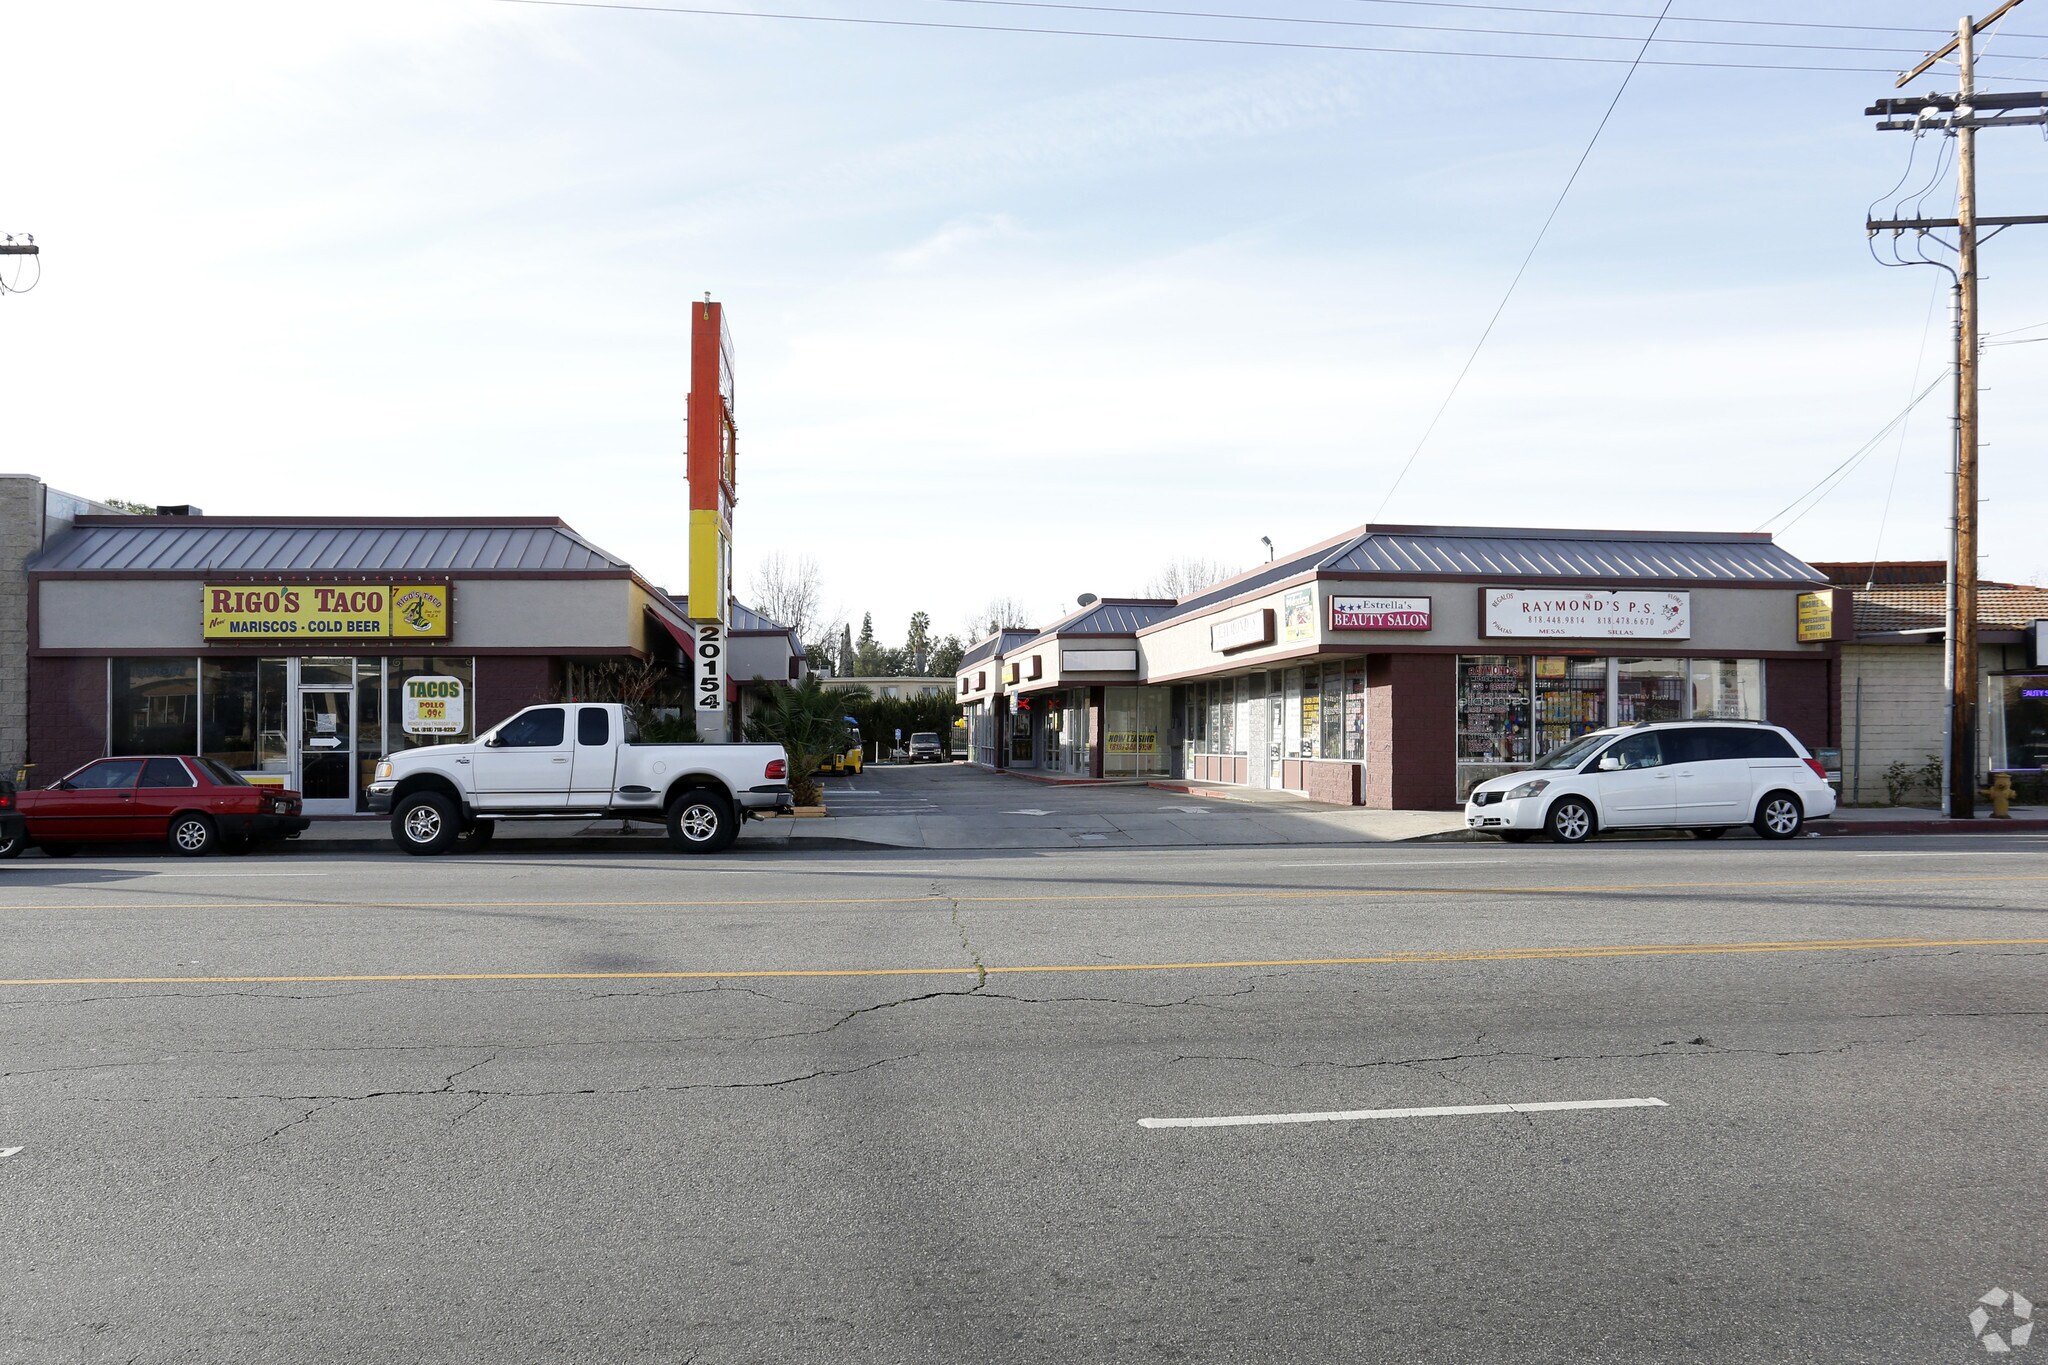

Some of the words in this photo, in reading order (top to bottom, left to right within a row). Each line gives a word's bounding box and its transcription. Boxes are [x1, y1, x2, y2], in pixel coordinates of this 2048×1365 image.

[211, 586, 300, 613] RIGO'S
[314, 588, 383, 613] TACO
[396, 591, 420, 608] RIGO'S
[423, 592, 442, 608] TACO
[1363, 600, 1412, 609] Estrella's
[1491, 592, 1514, 608] REGALOS
[1667, 593, 1683, 607] FLORES
[1522, 600, 1620, 613] RAYMOND'S
[1629, 602, 1656, 615] P.S.
[230, 620, 298, 633] MARISCOS
[307, 620, 343, 633] COLD
[346, 620, 380, 633] BEER
[1334, 613, 1385, 626] BEAUTY
[1387, 613, 1428, 626] SALON
[1528, 615, 1585, 624] 818.448.9814
[1597, 616, 1655, 626] 818.478.6670
[1663, 619, 1685, 635] JUMPERS
[698, 626, 721, 709] 20154
[407, 682, 459, 697] TACOS
